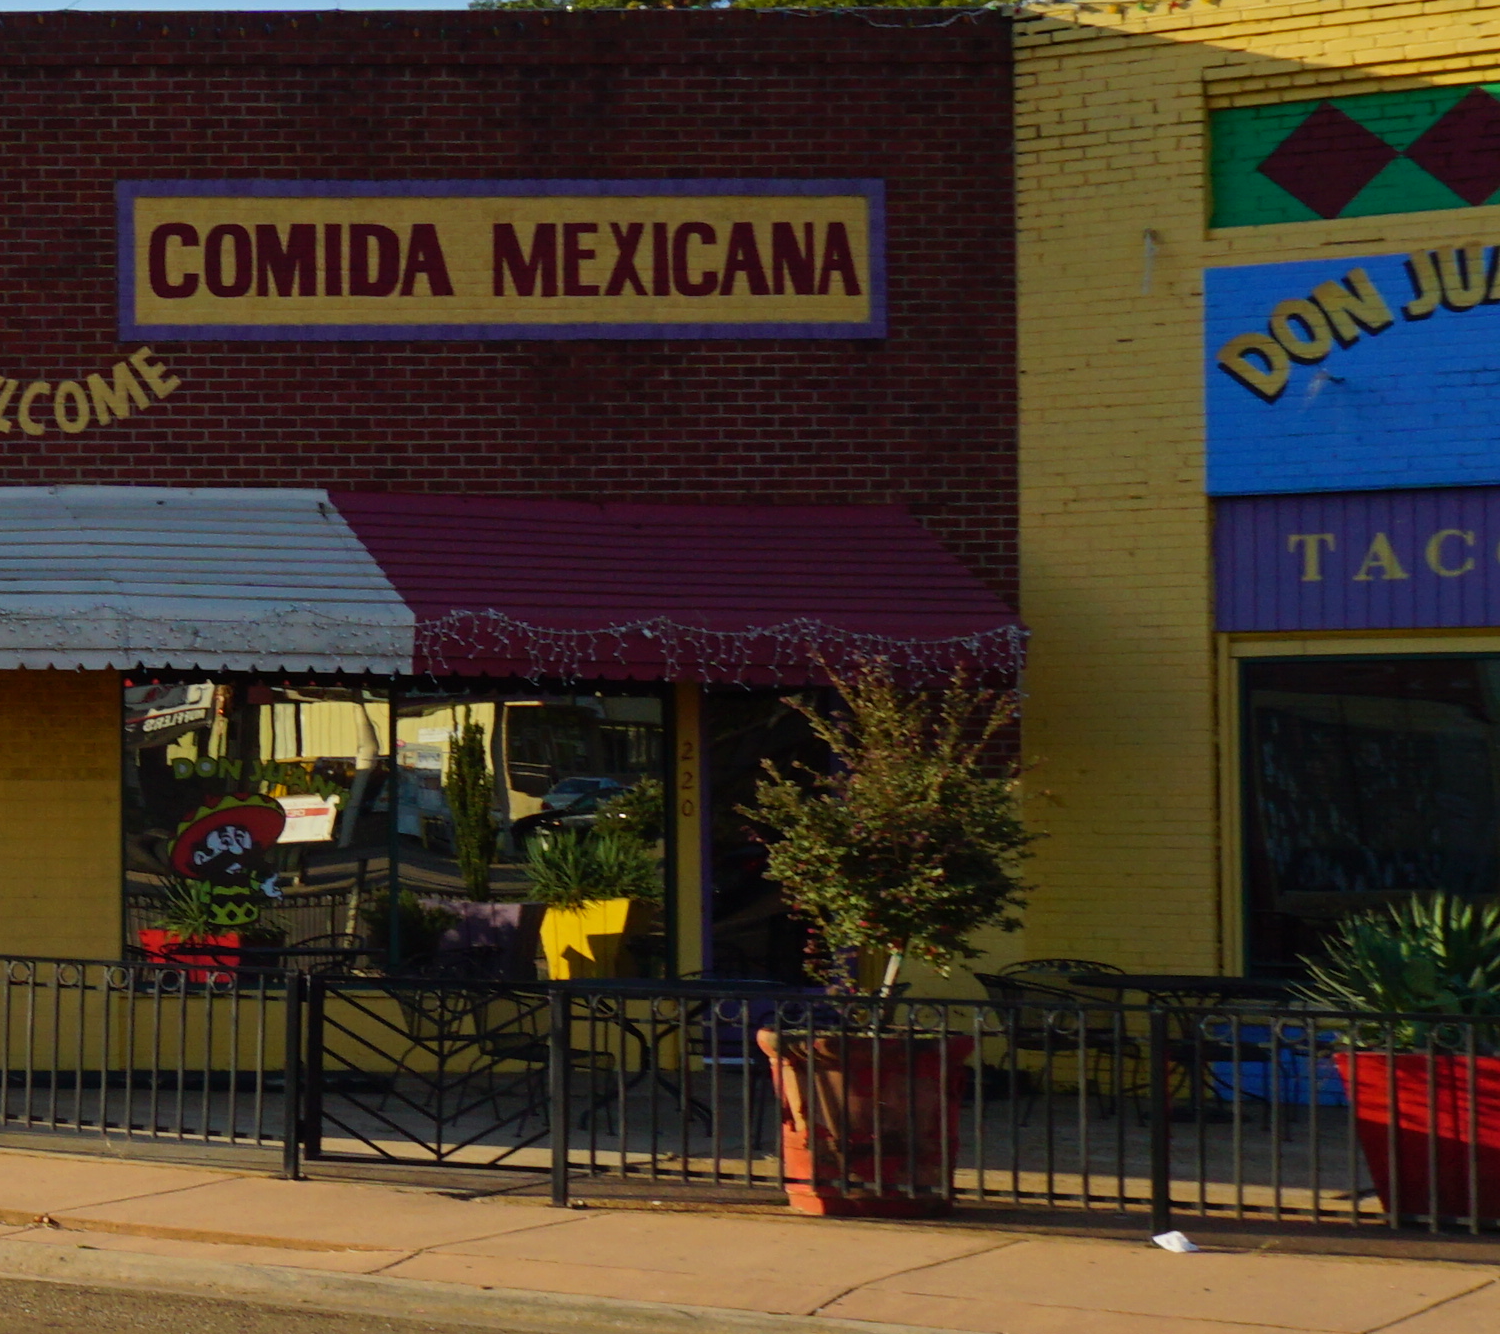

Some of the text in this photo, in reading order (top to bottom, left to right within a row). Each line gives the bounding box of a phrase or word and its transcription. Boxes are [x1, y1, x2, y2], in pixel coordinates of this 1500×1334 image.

[147, 222, 863, 299] COMIDA MEXICANA
[1216, 268, 1395, 404] DON
[1287, 528, 1500, 582] TAC
[172, 756, 243, 780] DON
[681, 740, 694, 817] 220
